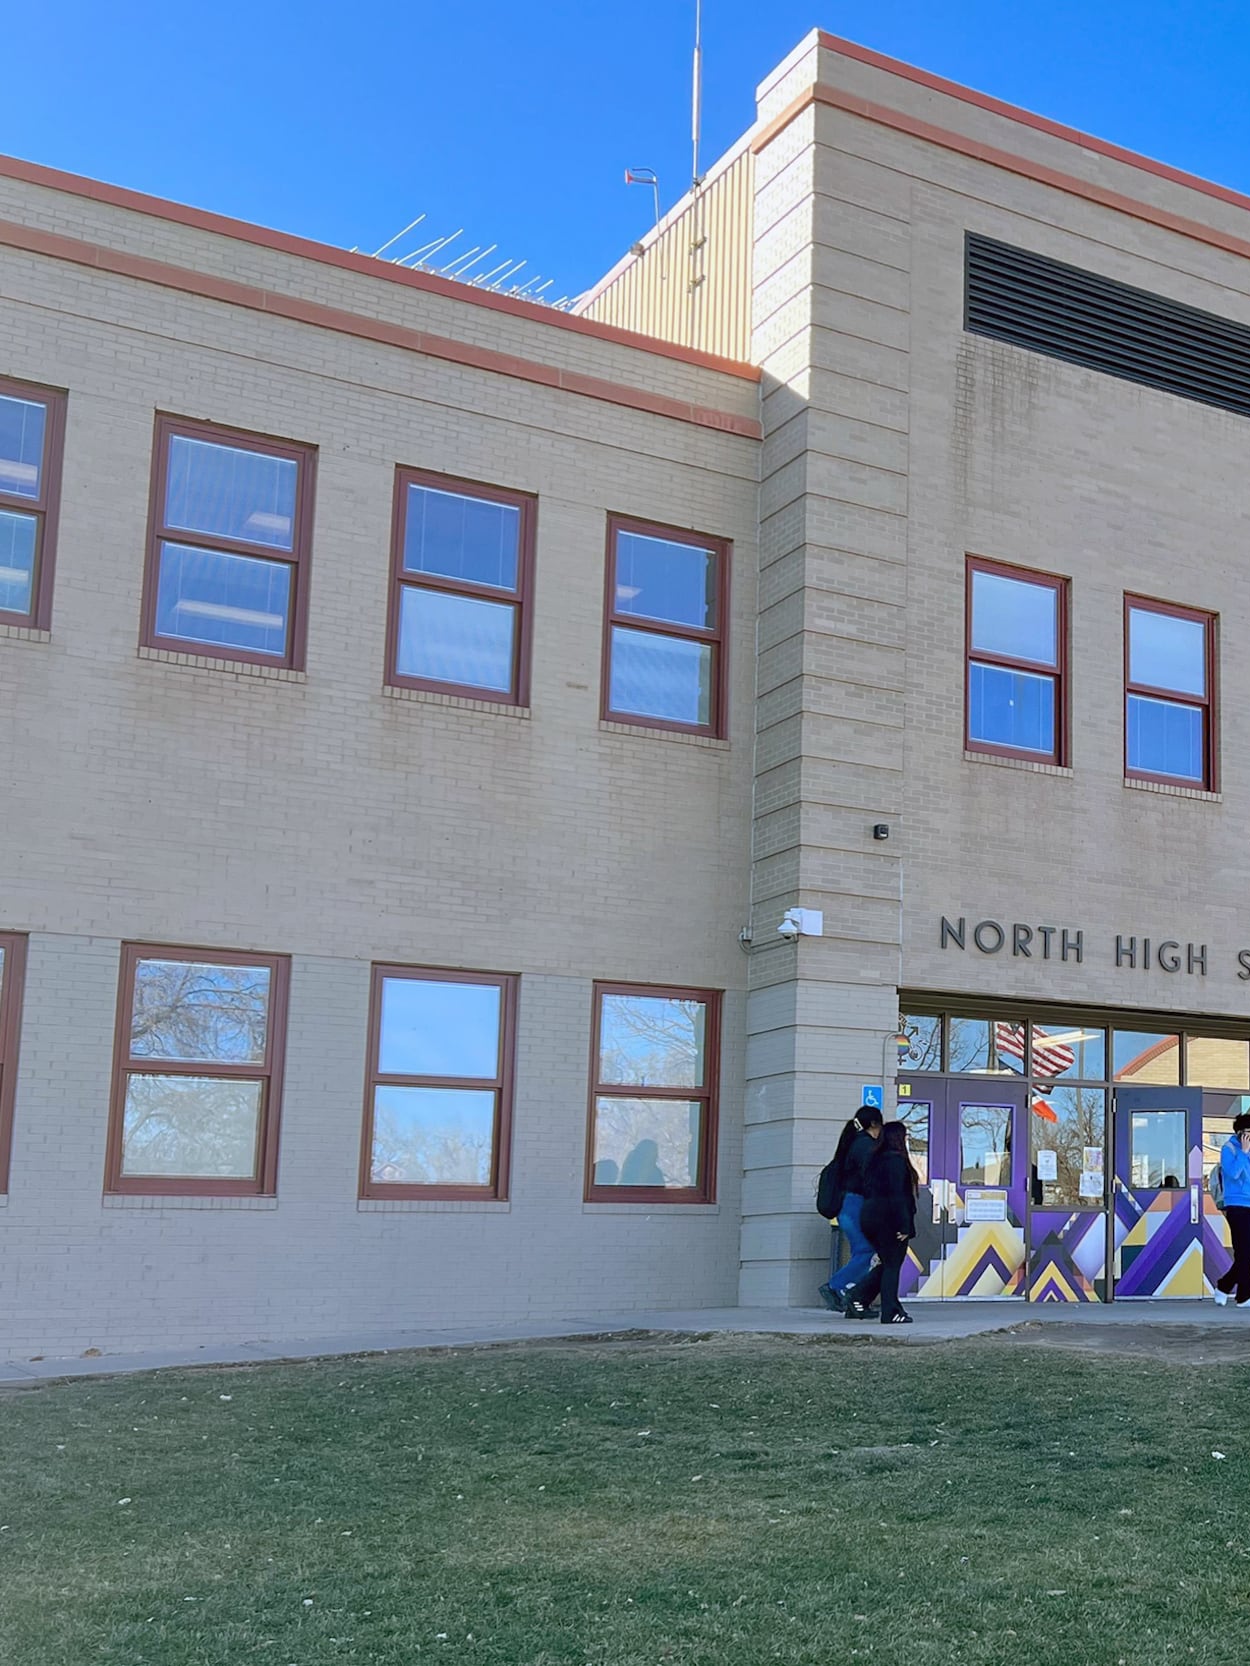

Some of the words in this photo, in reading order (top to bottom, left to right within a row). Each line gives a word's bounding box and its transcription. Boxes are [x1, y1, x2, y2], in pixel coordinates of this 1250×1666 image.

[940, 915, 1084, 964] NORTH
[1115, 934, 1208, 977] HIGH
[900, 1085, 907, 1095] 1
